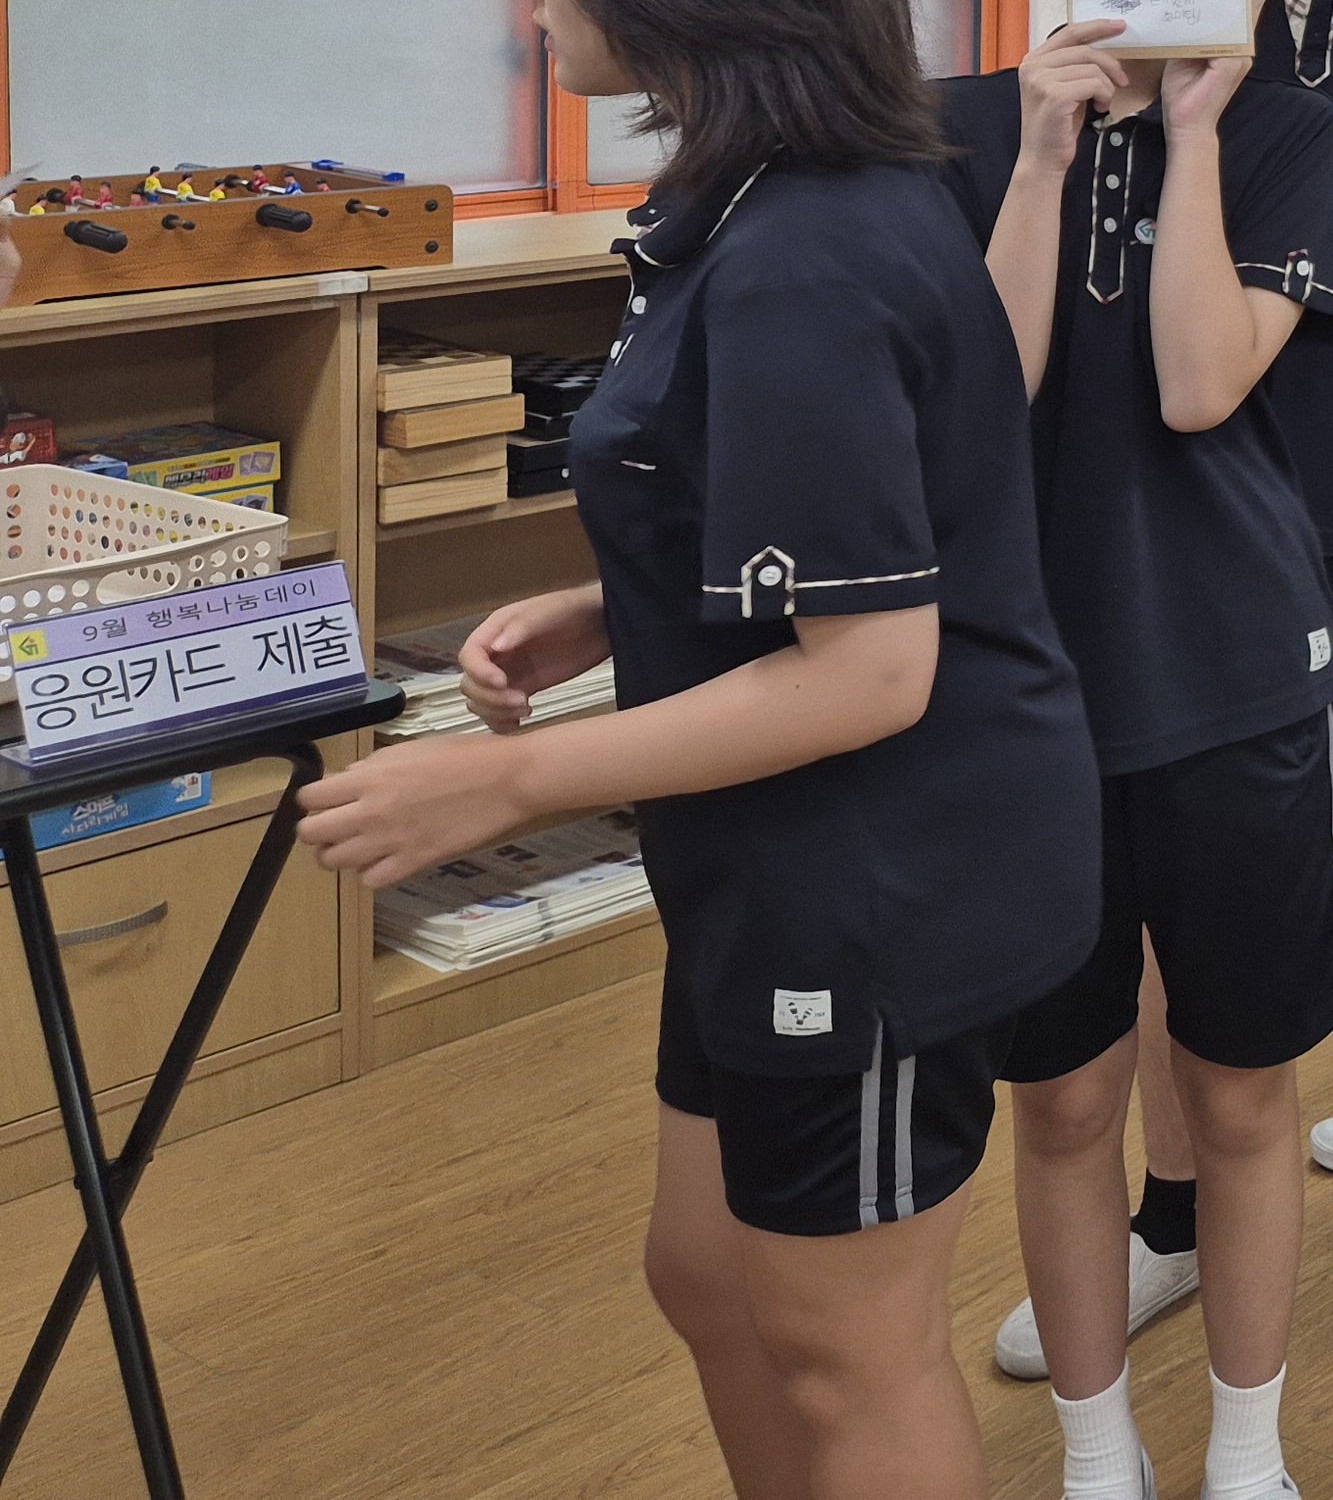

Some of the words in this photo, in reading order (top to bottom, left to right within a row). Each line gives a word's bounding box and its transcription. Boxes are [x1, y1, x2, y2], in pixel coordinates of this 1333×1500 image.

[81, 616, 128, 643] 9월
[145, 577, 318, 629] 행복나눔데이
[24, 642, 237, 732] 응원카드
[252, 614, 353, 677] 제출
